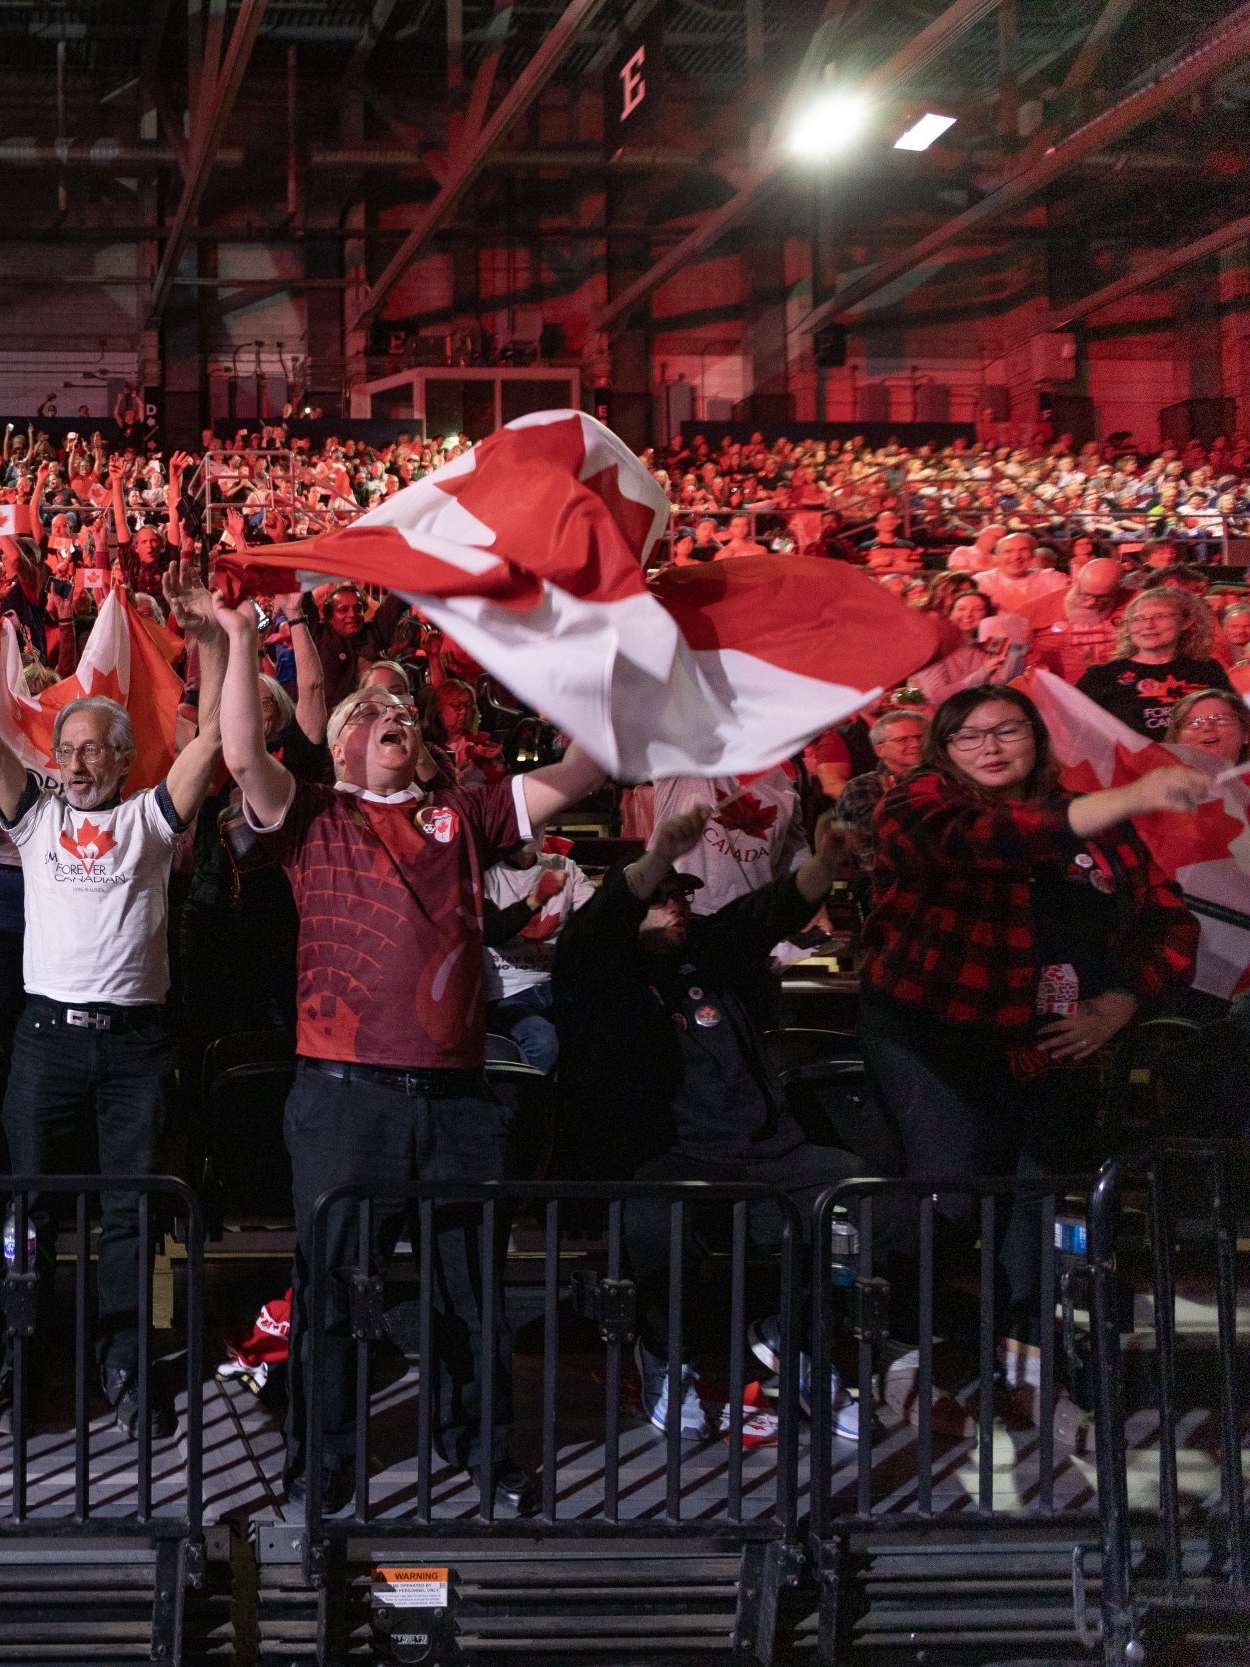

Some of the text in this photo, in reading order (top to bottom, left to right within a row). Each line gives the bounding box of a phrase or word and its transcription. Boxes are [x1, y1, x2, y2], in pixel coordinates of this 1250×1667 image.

[619, 44, 645, 122] E
[146, 404, 157, 415] D
[55, 859, 107, 877] FOREVER
[54, 873, 126, 884] CANADIAN
[394, 1572, 439, 1580] WARNING
